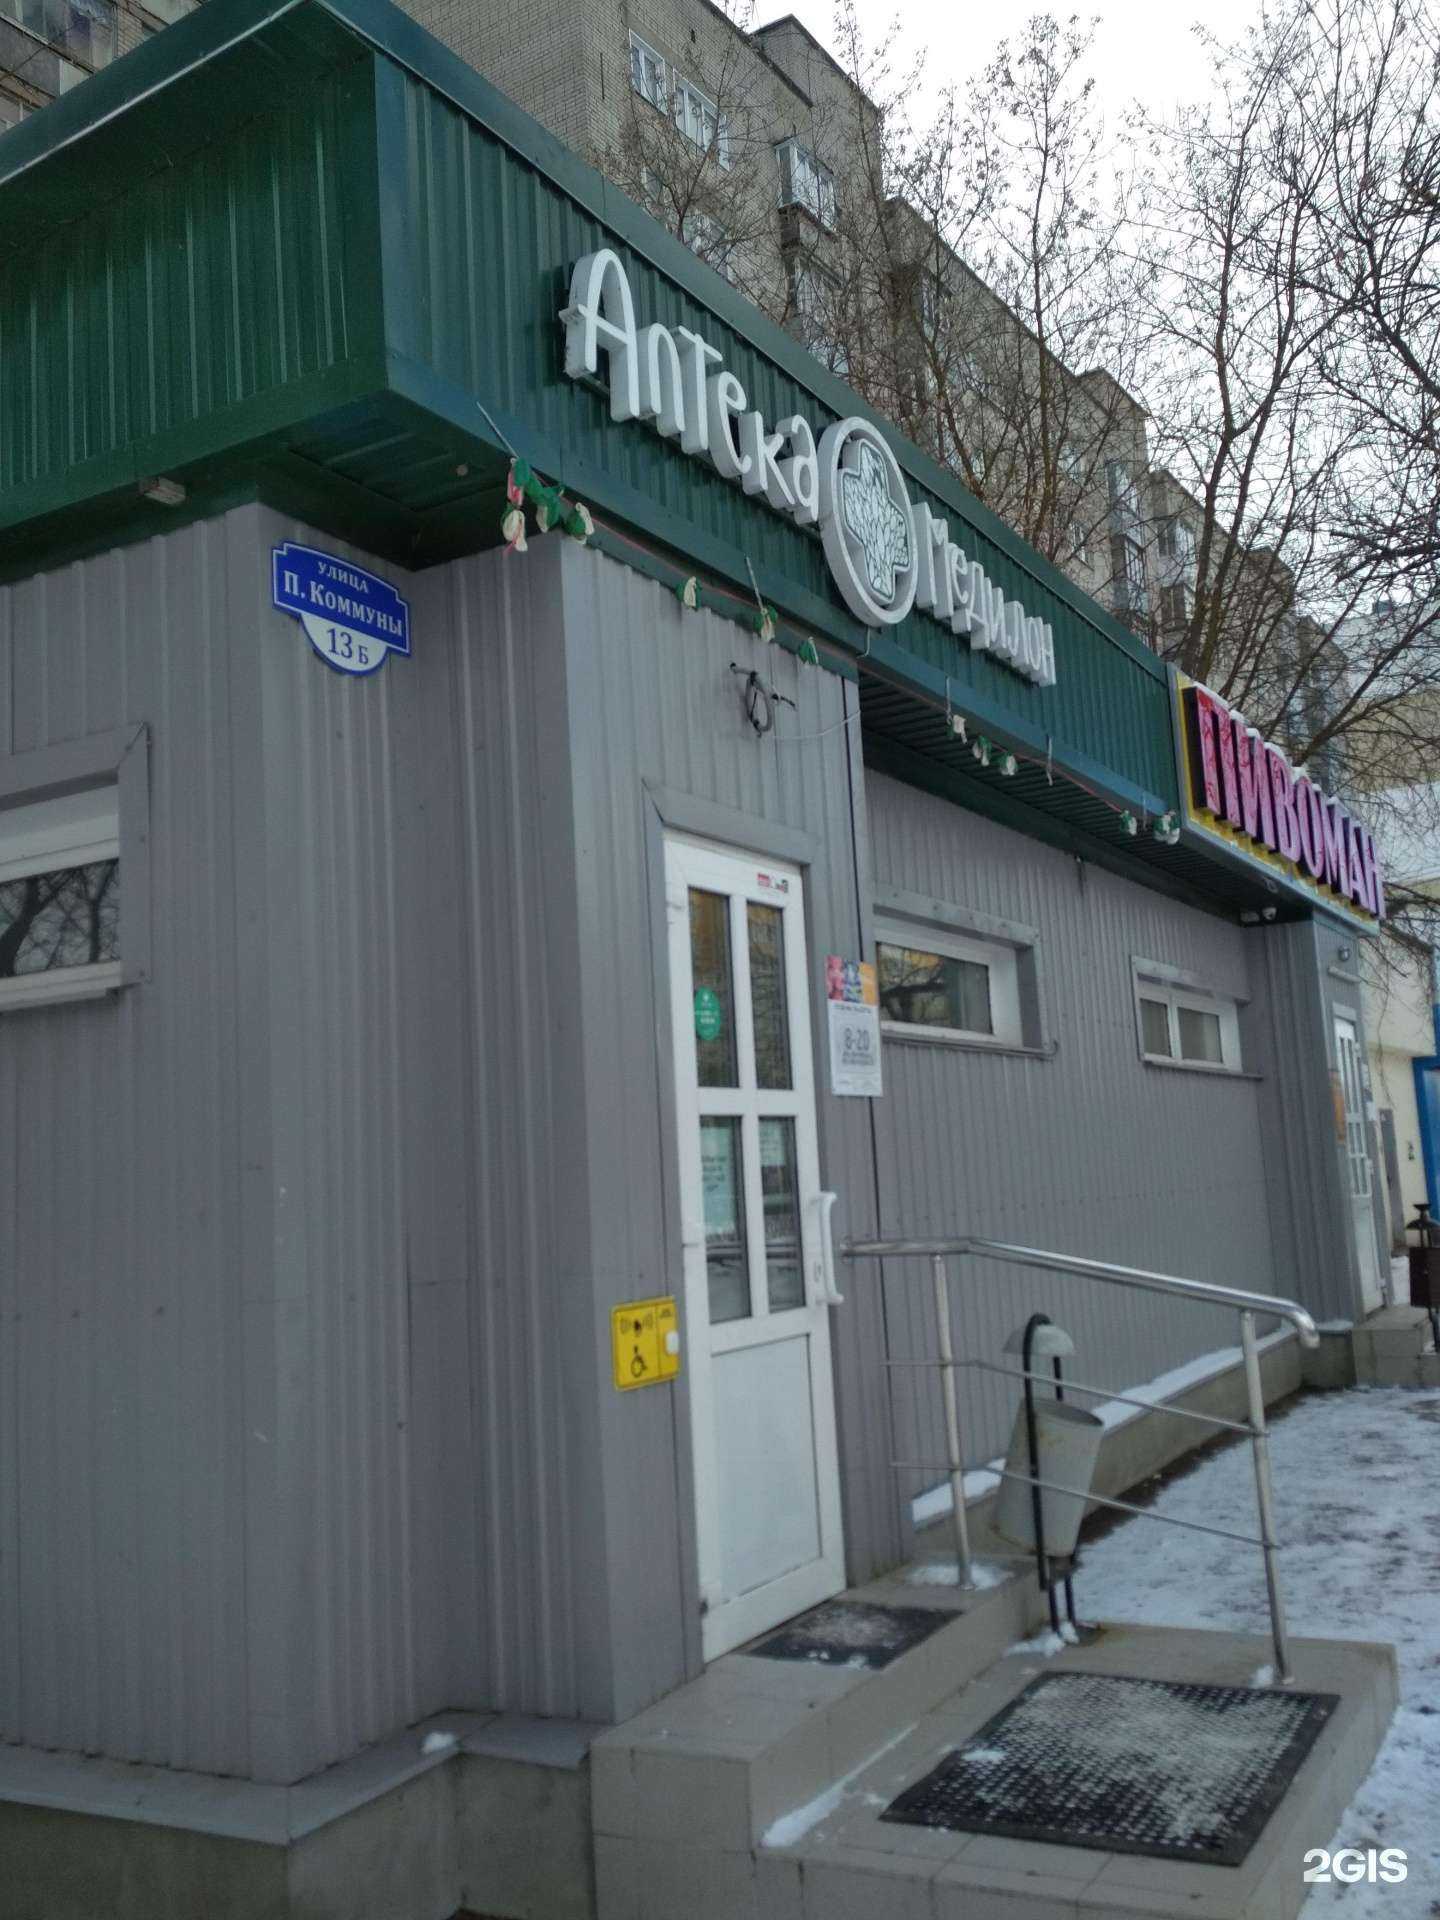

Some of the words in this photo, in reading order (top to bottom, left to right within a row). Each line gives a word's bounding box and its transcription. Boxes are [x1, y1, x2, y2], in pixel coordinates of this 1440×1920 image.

[559, 248, 818, 523] Аптека
[912, 502, 1056, 687] Медилон
[284, 570, 305, 599] П.
[317, 561, 369, 594] УЛИЦА
[1187, 684, 1387, 921] ПИВОМАН
